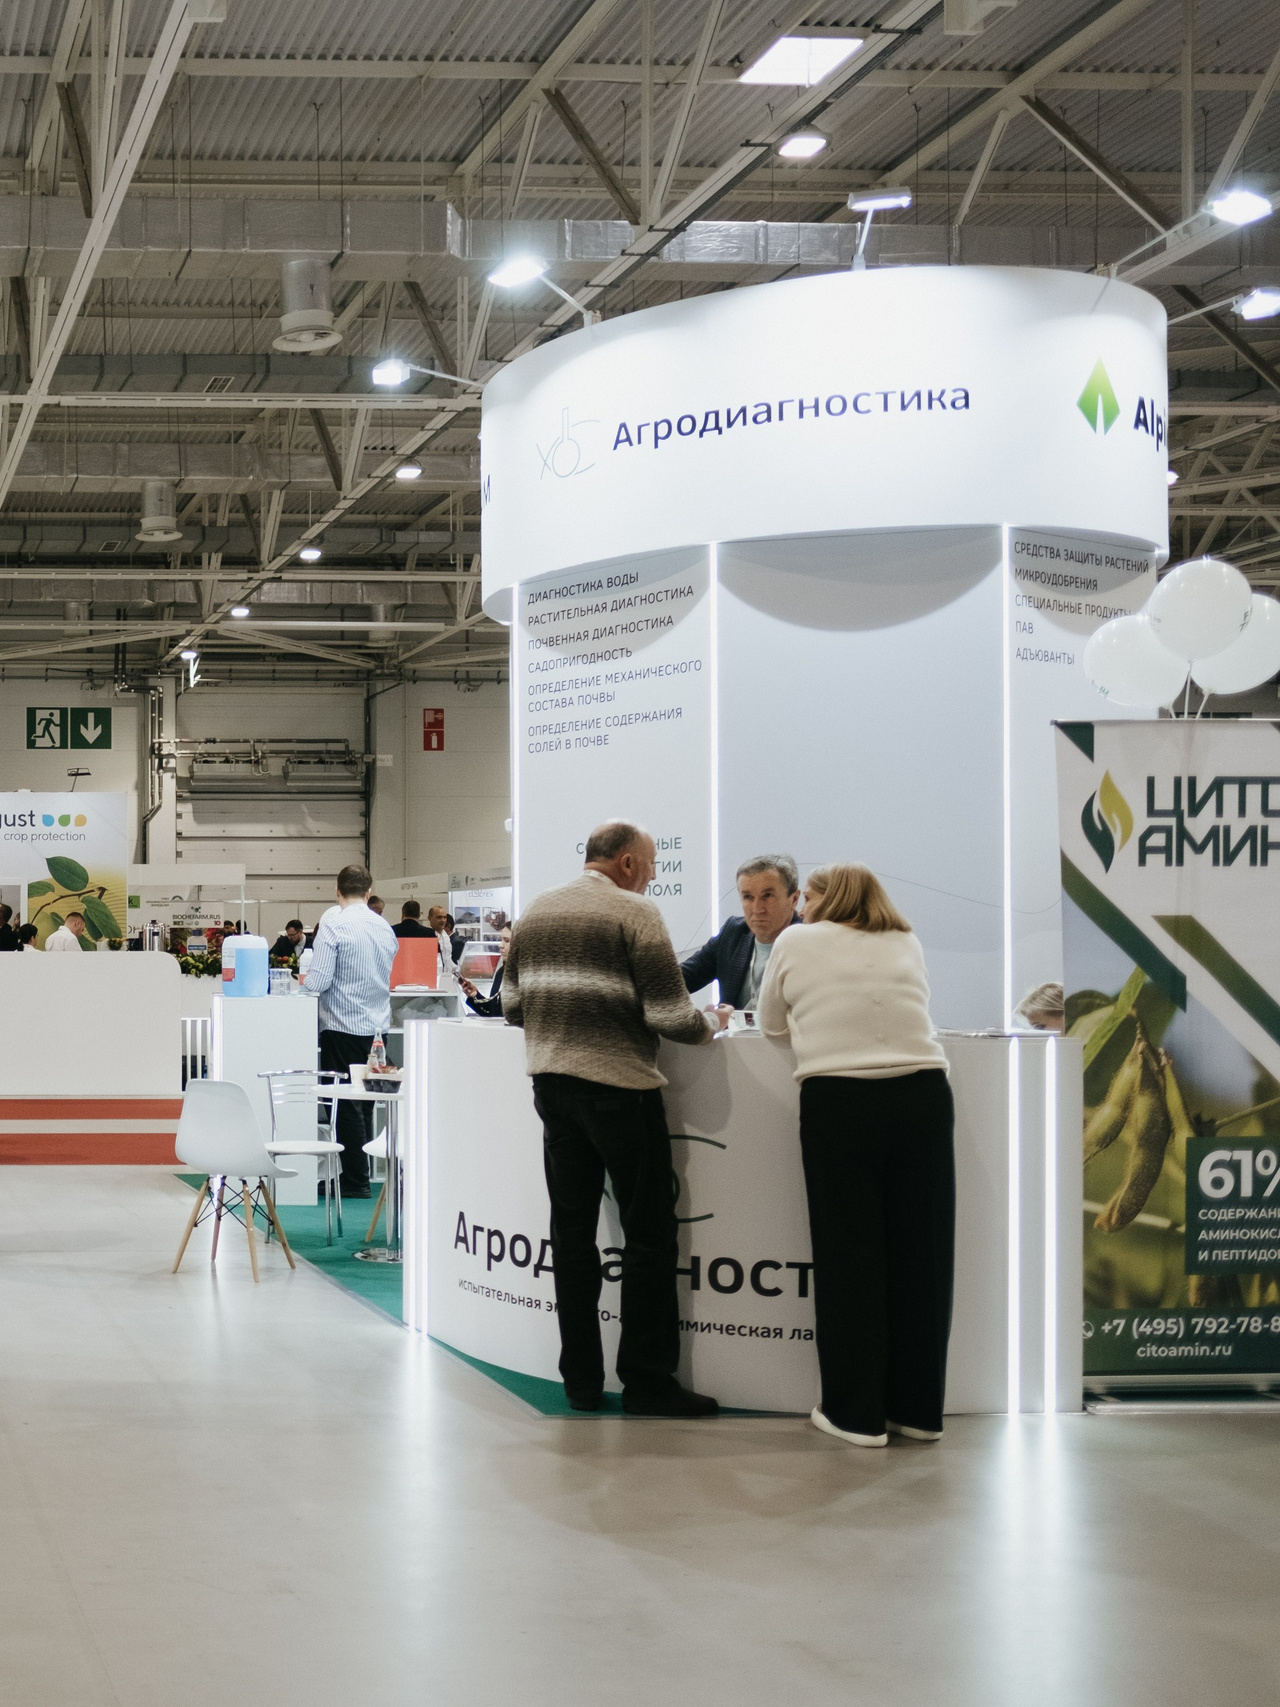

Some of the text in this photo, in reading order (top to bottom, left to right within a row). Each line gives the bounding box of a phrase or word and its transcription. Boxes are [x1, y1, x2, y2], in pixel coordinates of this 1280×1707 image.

[613, 387, 970, 450] Агродиагностика
[1014, 541, 1149, 574] СРЕДСТВА ЗАЩИТЫ РАСТЕНИЙ
[528, 572, 639, 605] ДИАГНОСТИКА ВОДЫ
[1015, 567, 1098, 591] МИКРОУДОБРЕНИЯ
[528, 585, 694, 627] РАСТИТЕЛЬНАЯ ДИАГНОСТИКА
[1015, 594, 1082, 615] СПЕЦИАЛЬНЫЕ
[528, 615, 674, 651] ПОЧВЕННАЯ ДИАГНОСТИКА
[1015, 620, 1034, 635] ПАВ
[528, 647, 633, 674] САДОПРИГОДНОСТЬ
[1016, 647, 1075, 665] АДЪЮВАНТЫ
[528, 659, 702, 696] ОПРЕДЕЛЕНИЕ МЕХАНИЧЕСКОГО
[528, 691, 616, 713] СОСТАВА ПОЧВЫ
[528, 707, 683, 737] ОПРЕДЕЛЕНИЕ СОДЕРЖАНИЯ
[528, 734, 610, 754] СОЛЕЙ В ПОЧВЕ
[3, 831, 86, 843] crop protection
[1198, 1207, 1280, 1222] СОДЕРЖАН
[1198, 1228, 1280, 1241] АМИНОКИС
[1199, 1249, 1280, 1262] И ПЕПТИДО
[458, 1278, 542, 1310] испытательная
[1101, 1319, 1126, 1336] +7
[1132, 1317, 1185, 1339] (495)
[1136, 1342, 1232, 1358] citoamin.ru
